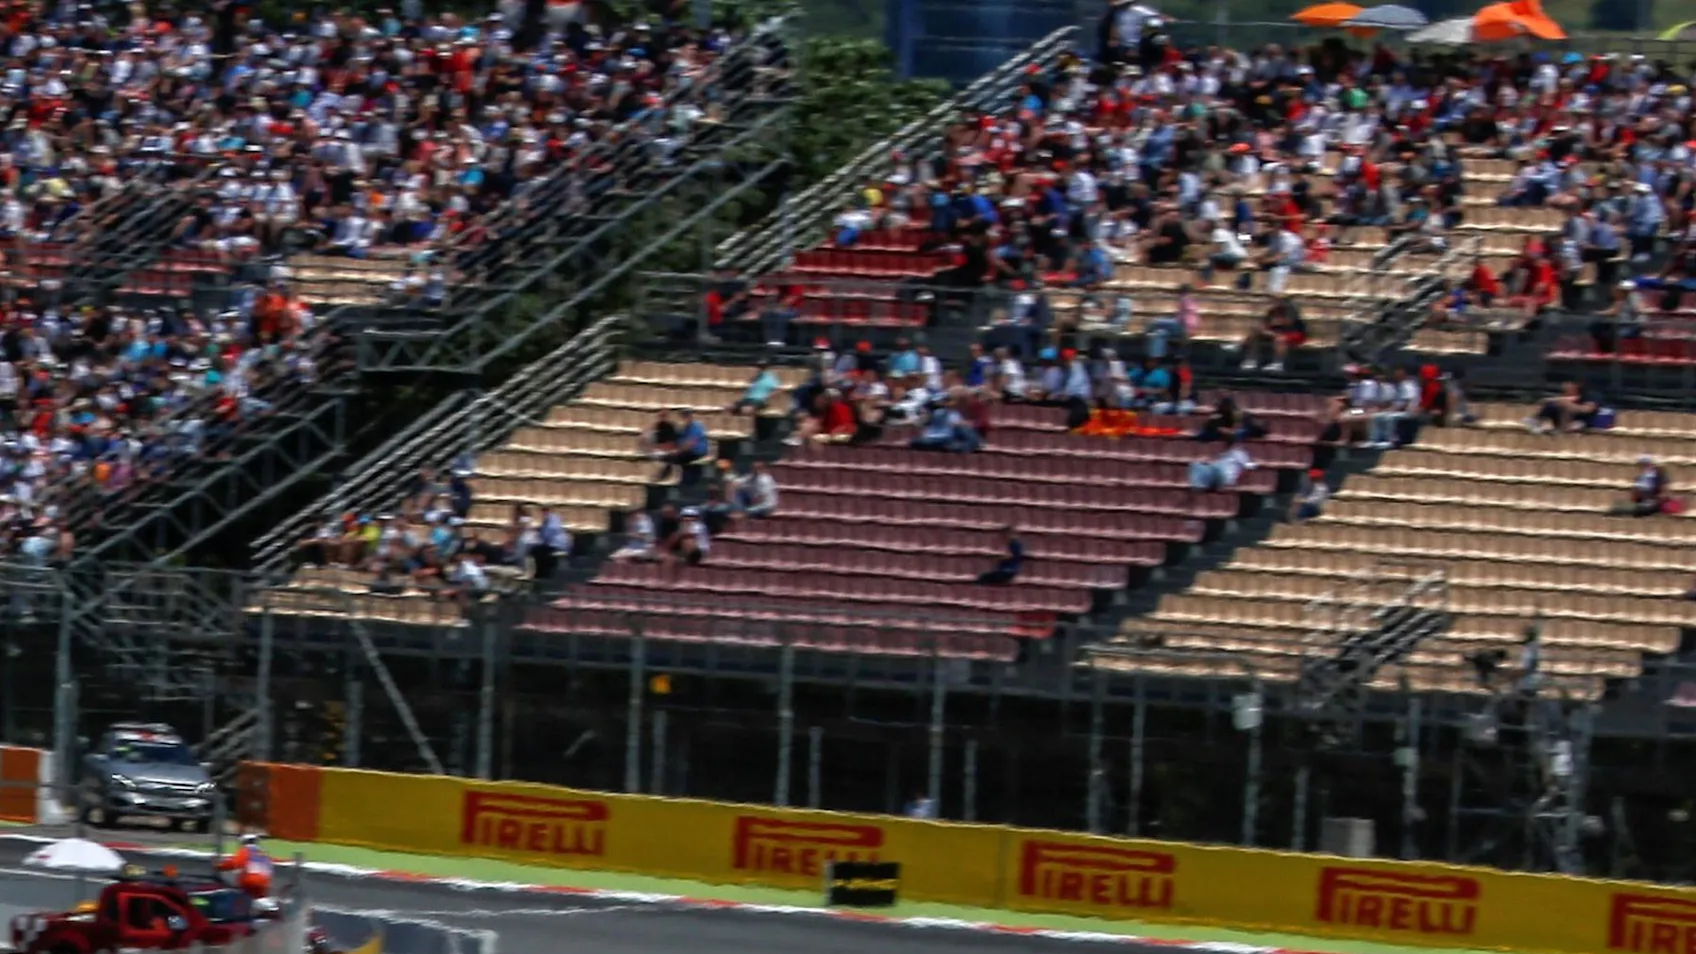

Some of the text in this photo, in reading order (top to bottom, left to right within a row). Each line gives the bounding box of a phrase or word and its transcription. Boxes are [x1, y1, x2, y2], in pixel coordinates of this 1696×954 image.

[462, 790, 609, 856] PIRELLI
[1020, 840, 1175, 908] PIRELLI
[1315, 866, 1481, 934] PIRELLI
